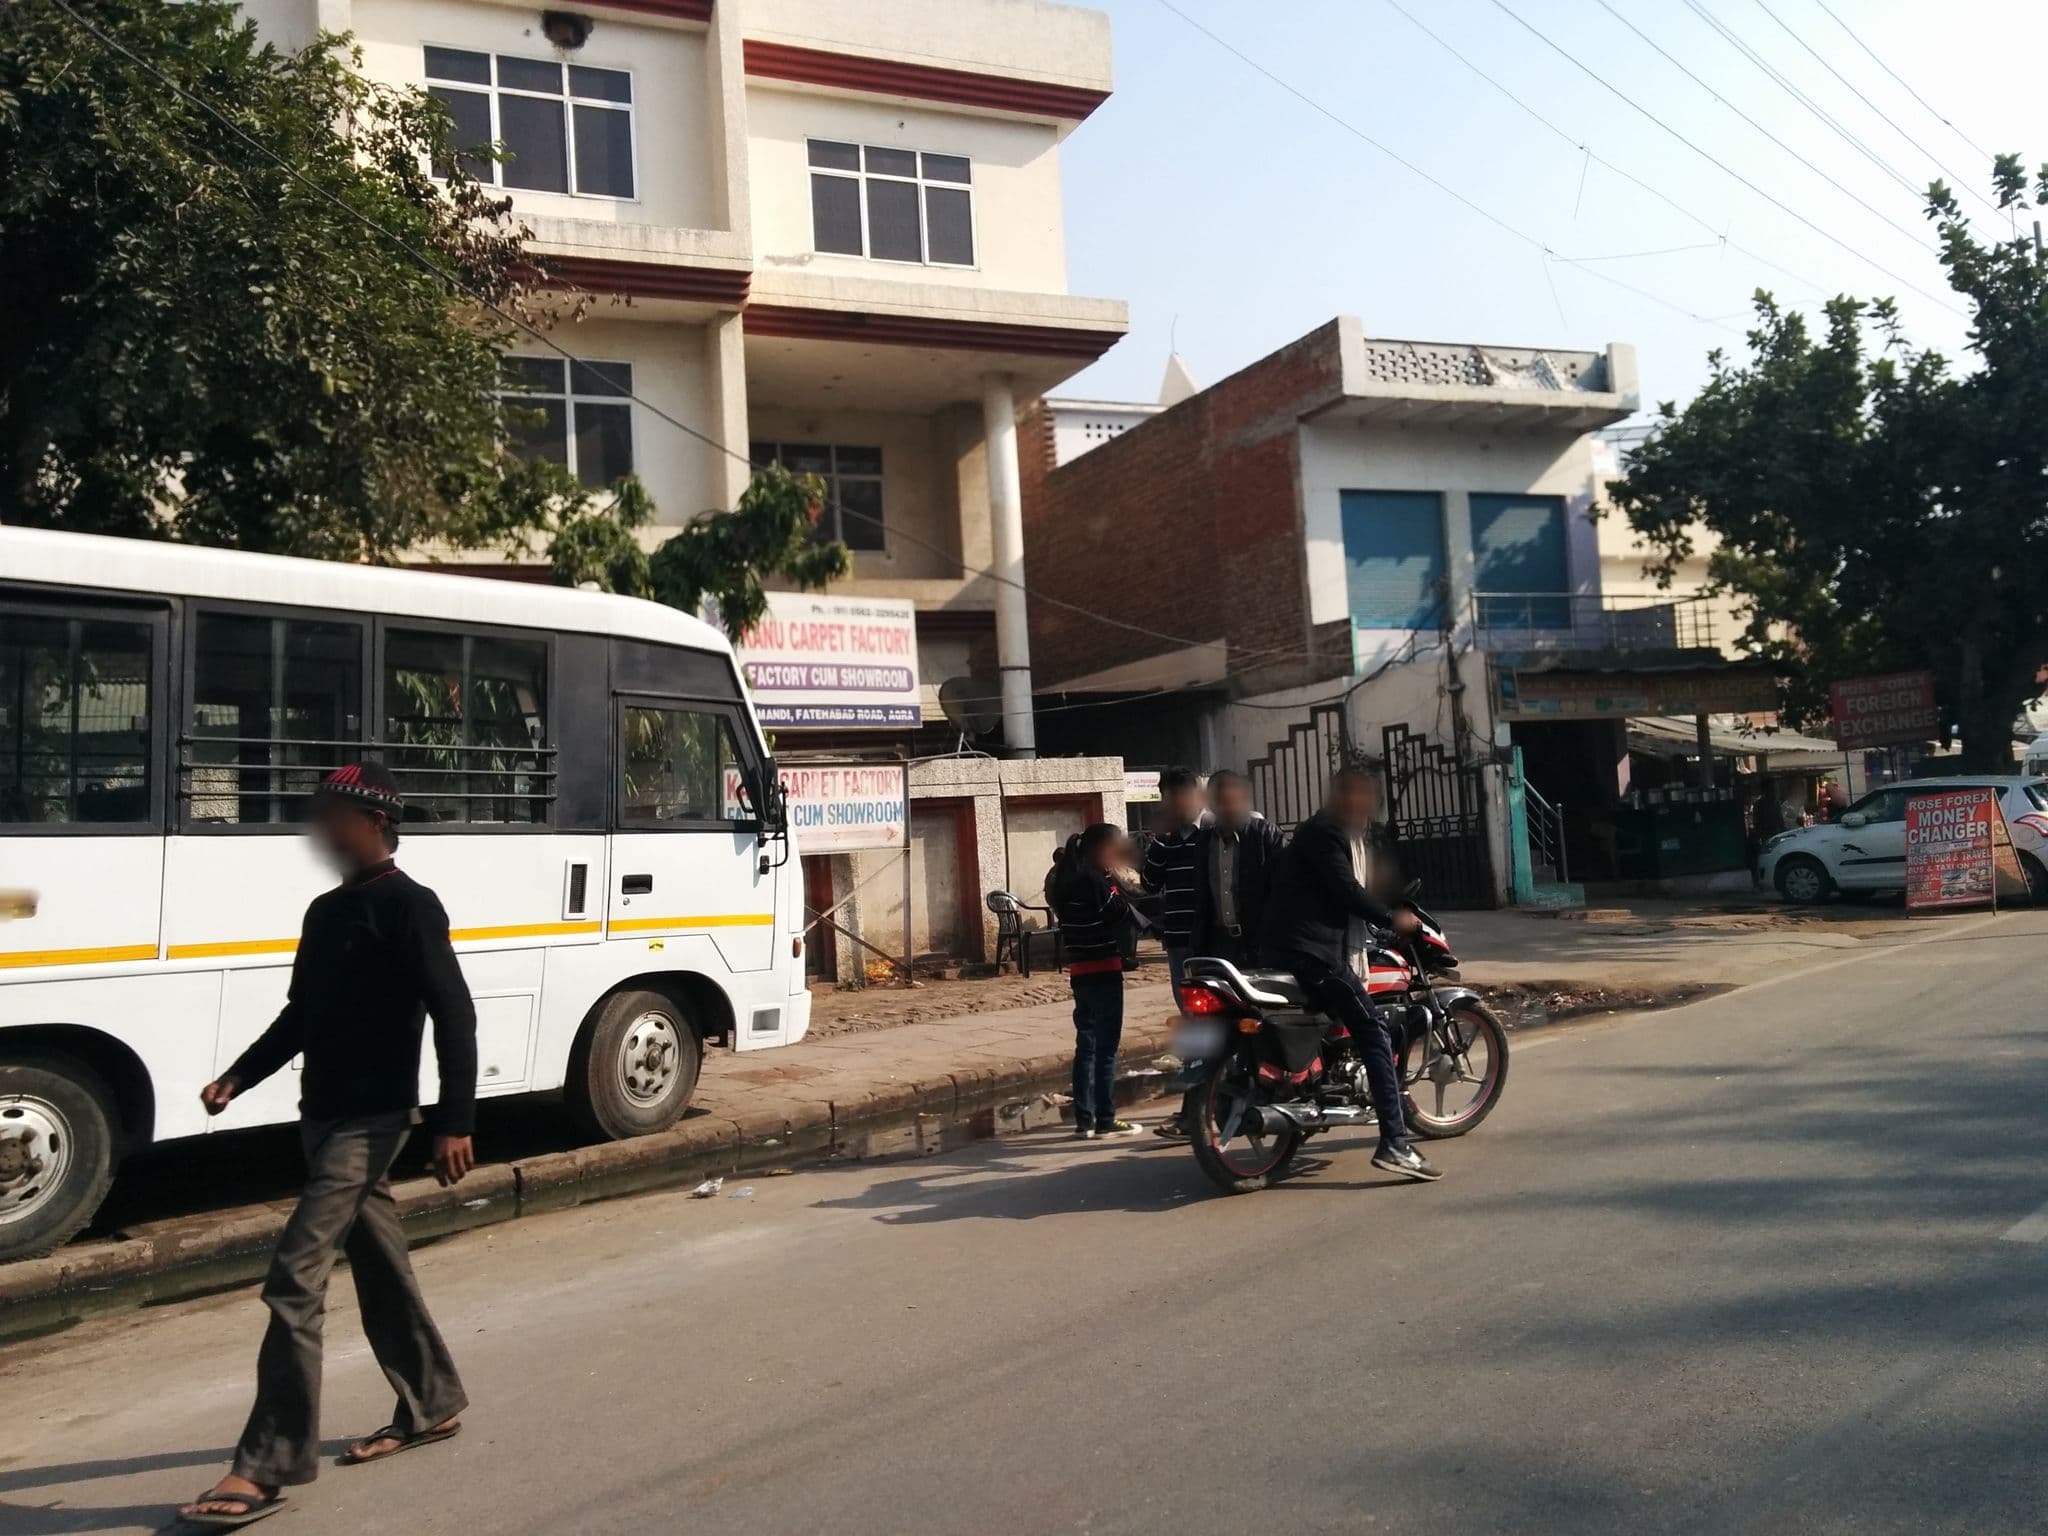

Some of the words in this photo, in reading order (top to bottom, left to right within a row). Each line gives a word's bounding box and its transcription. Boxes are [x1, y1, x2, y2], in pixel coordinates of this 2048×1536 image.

[742, 621, 784, 651] KANU
[789, 623, 845, 652] CARPET
[851, 626, 911, 656] FACTORY
[748, 665, 807, 687] FACTORY
[811, 667, 838, 687] CUM
[840, 668, 908, 689] SHOWROOM
[1846, 689, 1922, 714] FOREIGN
[796, 708, 855, 721] FATEHABAD
[857, 709, 887, 723] ROAD,
[889, 710, 914, 721] AGRA
[1839, 710, 1935, 737] EXCHANGE
[781, 769, 838, 800] CARPET
[844, 768, 901, 797] FACTORY
[1908, 799, 1942, 811] ROSE
[1947, 793, 1990, 806] FOREX
[794, 804, 823, 827] CUM
[828, 801, 904, 826] SHOWROOM
[1919, 806, 1977, 827] MONEY
[1908, 821, 1988, 844] CHANGER
[1907, 854, 1928, 865] ROSE
[1931, 852, 1952, 863] TOUR
[1935, 863, 1954, 871] TAXI
